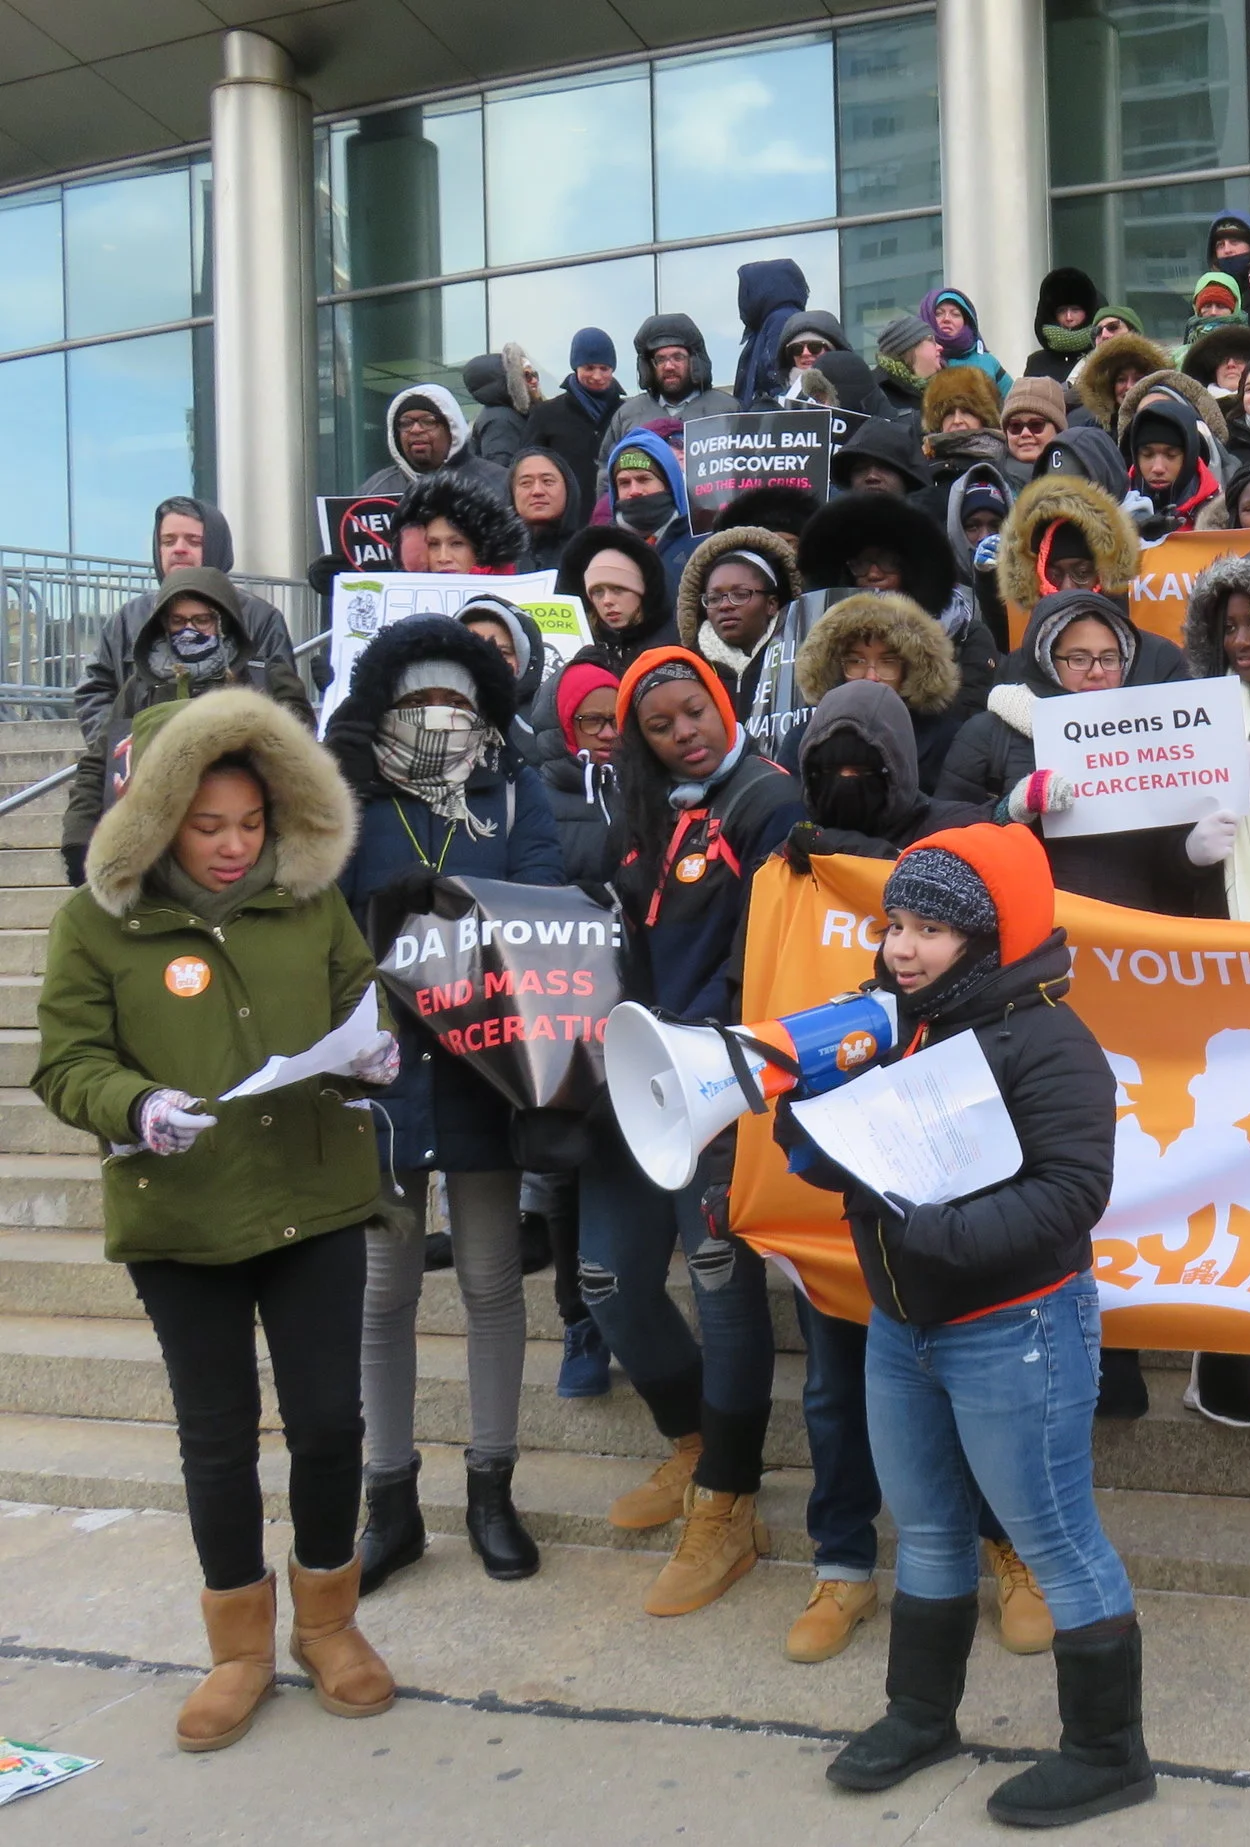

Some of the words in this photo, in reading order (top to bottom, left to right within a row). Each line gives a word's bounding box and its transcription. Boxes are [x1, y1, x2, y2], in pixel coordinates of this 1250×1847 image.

[690, 432, 780, 457] OVERHAUL
[780, 431, 823, 449] BAIL
[697, 462, 707, 478] &
[709, 455, 810, 476] DISCOVERY
[694, 482, 713, 496] END
[716, 478, 736, 490] THE
[1063, 715, 1164, 744] Queens
[1172, 707, 1212, 729] DA
[1086, 750, 1130, 770] END
[1137, 743, 1196, 764] MASS
[1072, 767, 1230, 799] NCARCERATION
[395, 926, 446, 970] DA
[458, 916, 622, 954] Brown:
[415, 978, 474, 1017] END
[483, 968, 595, 1000] MASS
